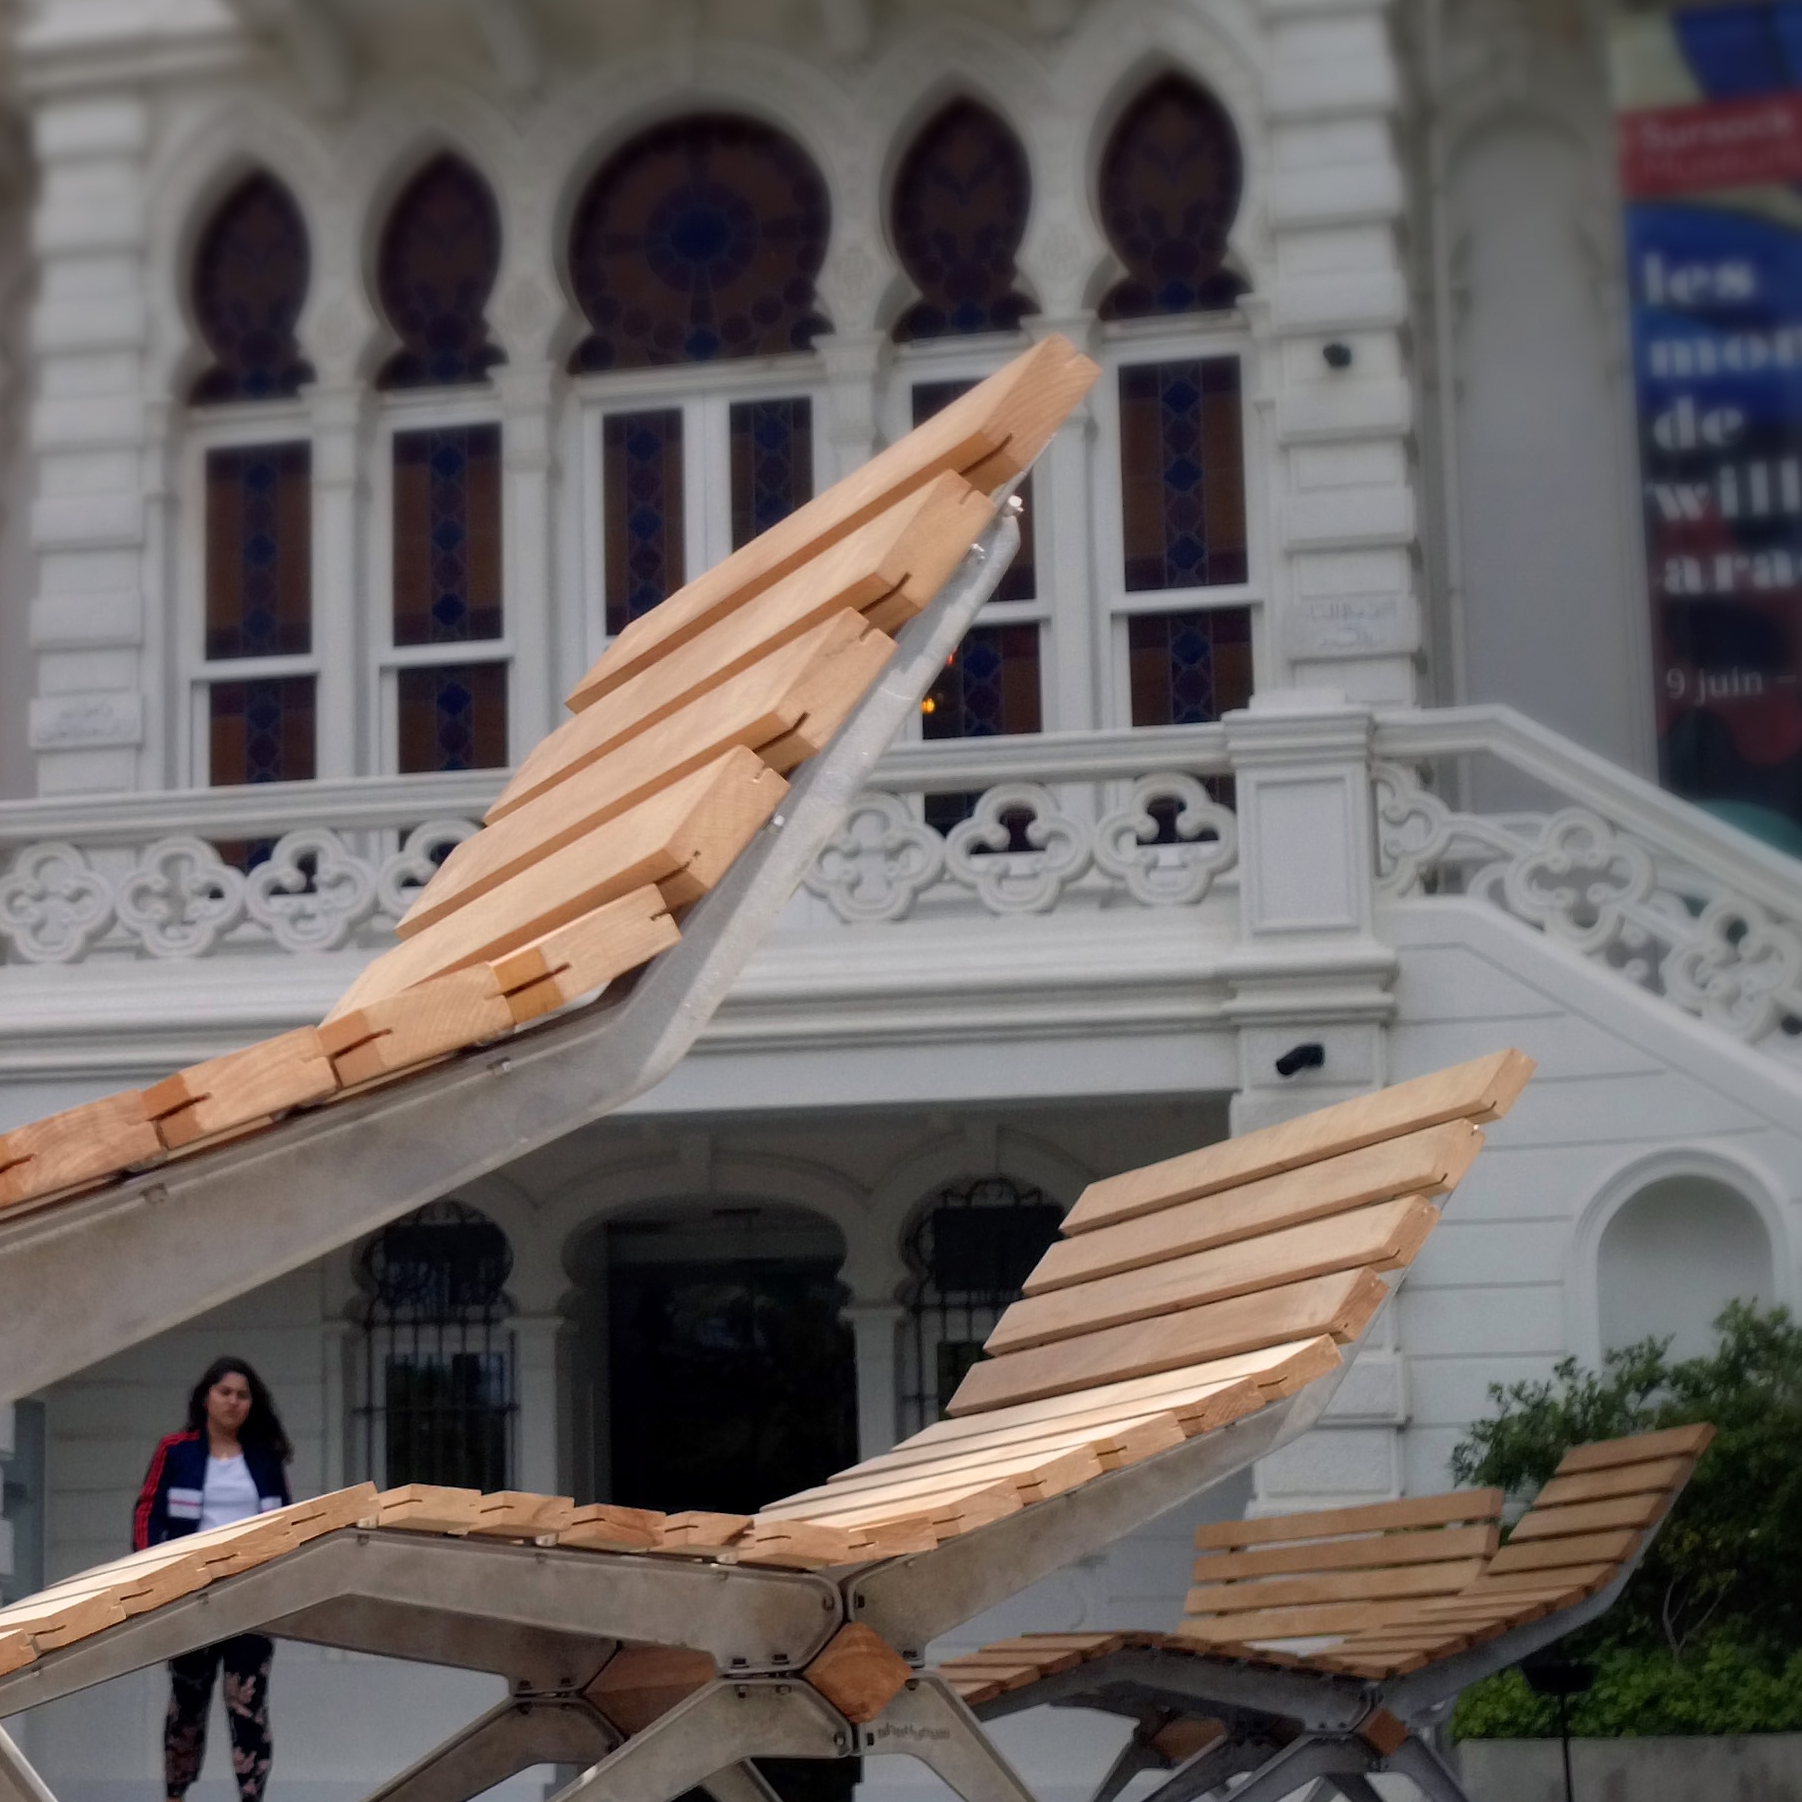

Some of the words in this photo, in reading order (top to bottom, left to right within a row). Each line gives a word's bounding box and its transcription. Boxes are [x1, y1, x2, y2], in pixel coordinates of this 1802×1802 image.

[1644, 252, 1755, 304] les
[1653, 394, 1745, 449] de
[1644, 457, 1802, 523] will
[1662, 548, 1802, 596] ara
[1666, 667, 1685, 699] 9
[1693, 665, 1763, 706] juin
